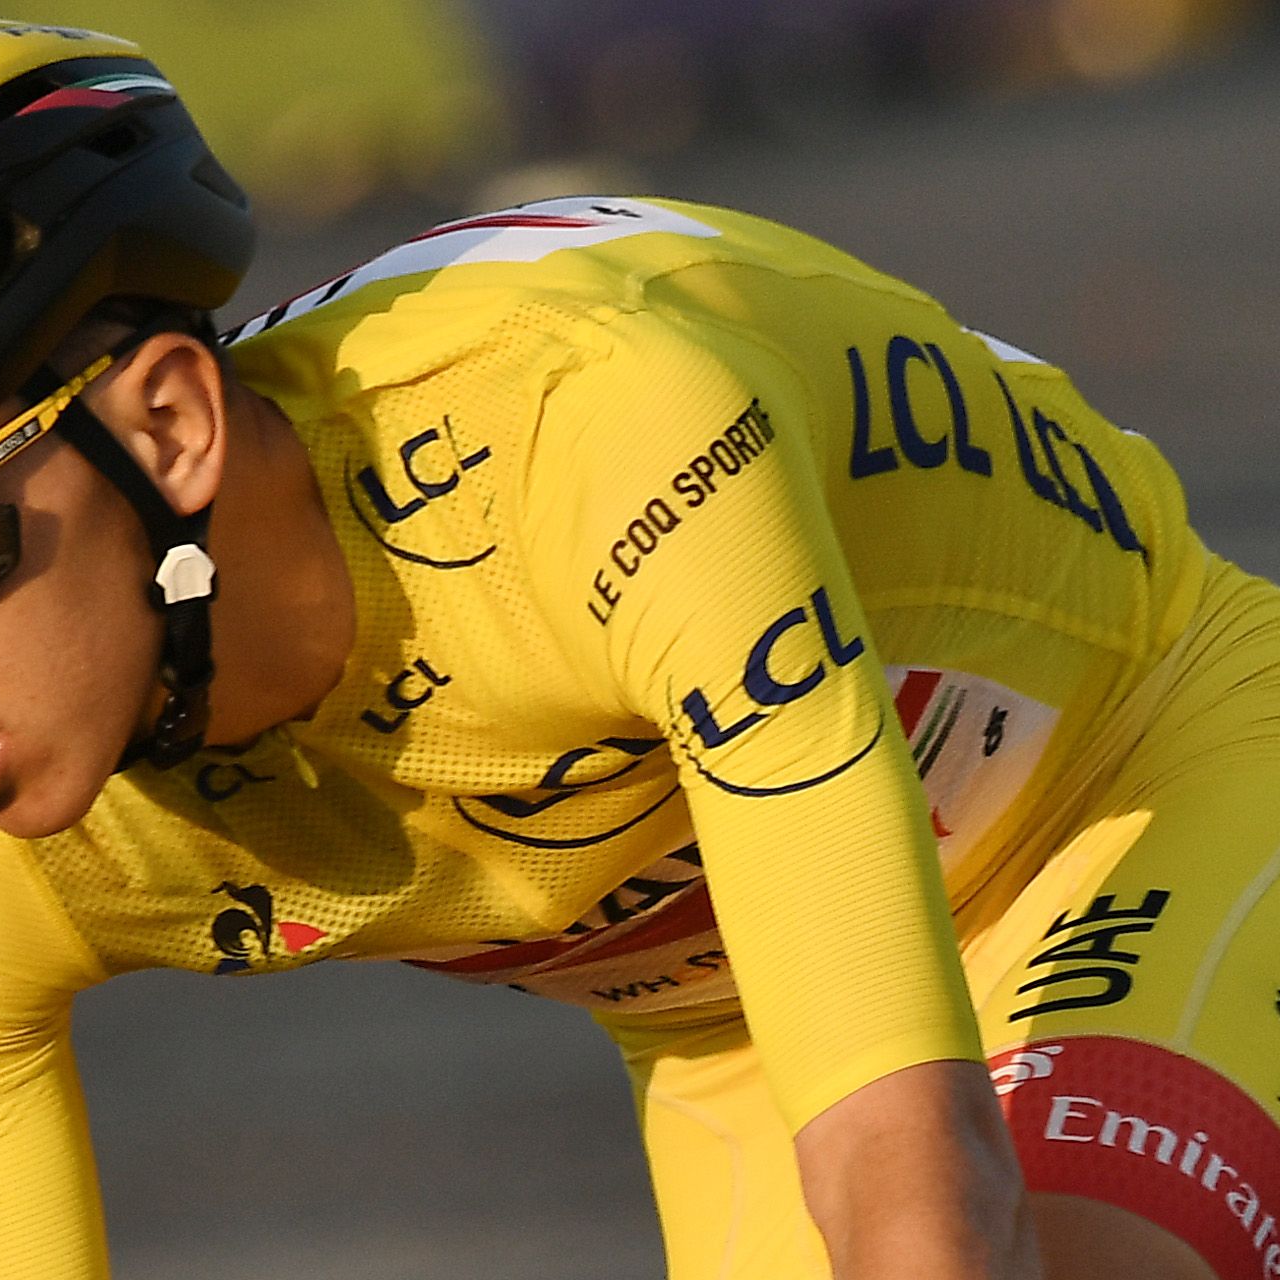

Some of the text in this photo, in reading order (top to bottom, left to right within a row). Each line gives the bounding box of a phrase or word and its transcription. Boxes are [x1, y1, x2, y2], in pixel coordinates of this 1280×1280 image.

[357, 413, 491, 526] LCL
[845, 334, 993, 480] LCL
[587, 568, 622, 627] LE
[609, 497, 683, 578] COQ
[359, 656, 452, 735] LCL
[681, 586, 864, 749] LCL
[1008, 888, 1172, 1023] UAE
